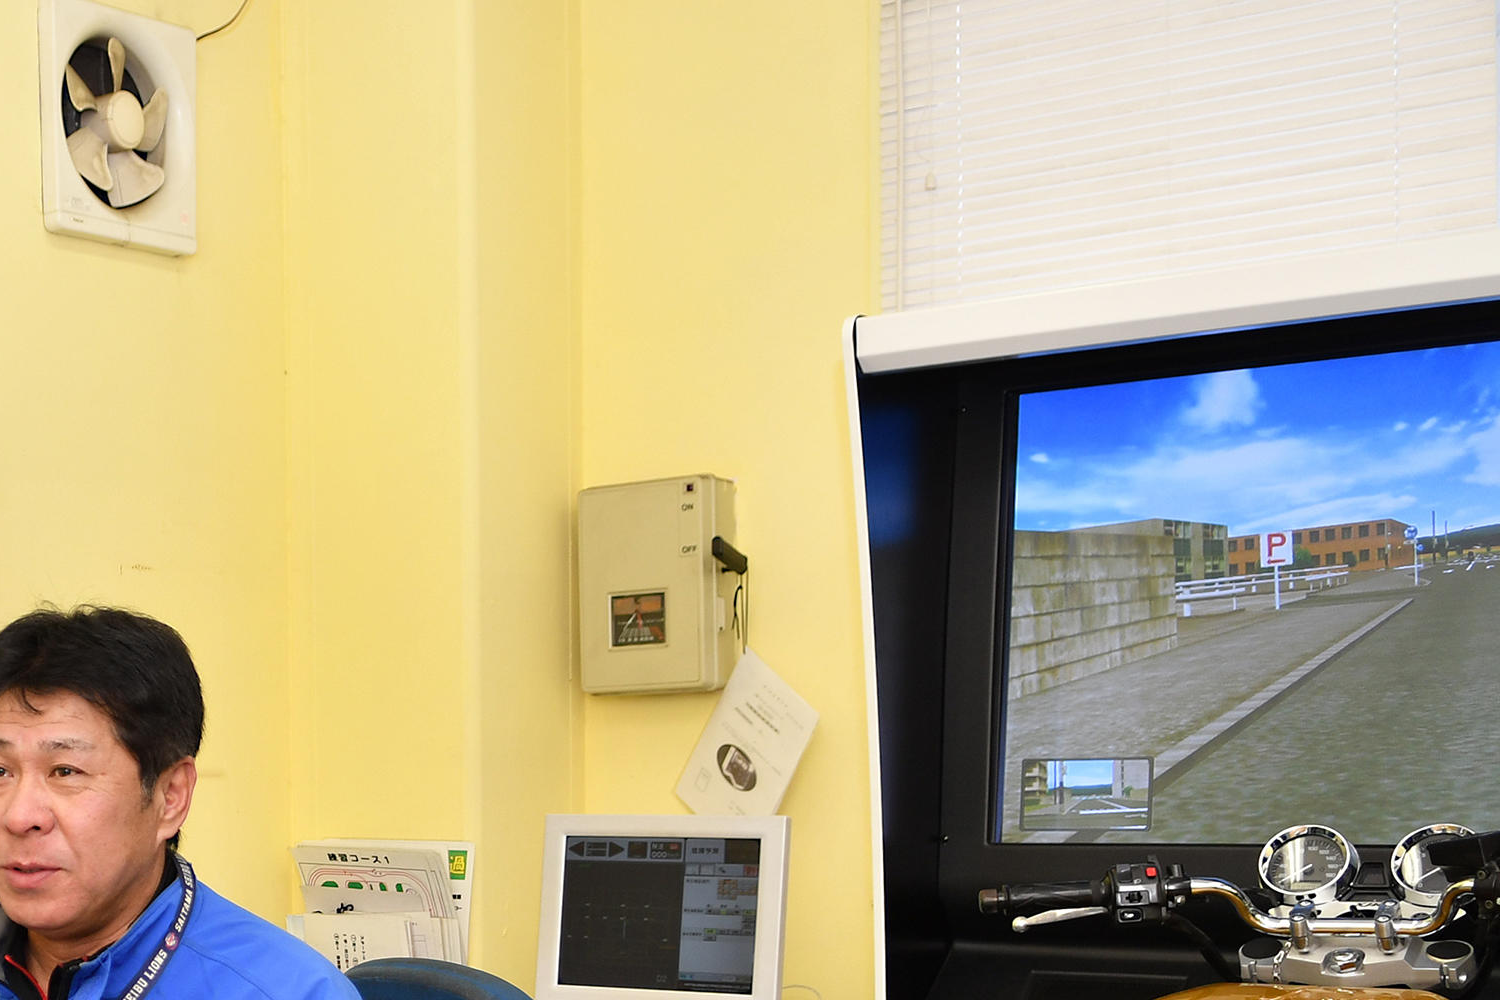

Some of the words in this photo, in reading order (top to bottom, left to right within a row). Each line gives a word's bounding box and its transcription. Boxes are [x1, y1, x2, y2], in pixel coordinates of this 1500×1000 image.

[681, 503, 694, 512] ON
[681, 545, 697, 553] OFF
[1267, 533, 1287, 557] P
[175, 889, 193, 932] SAITAMA
[144, 949, 168, 980] LIONS
